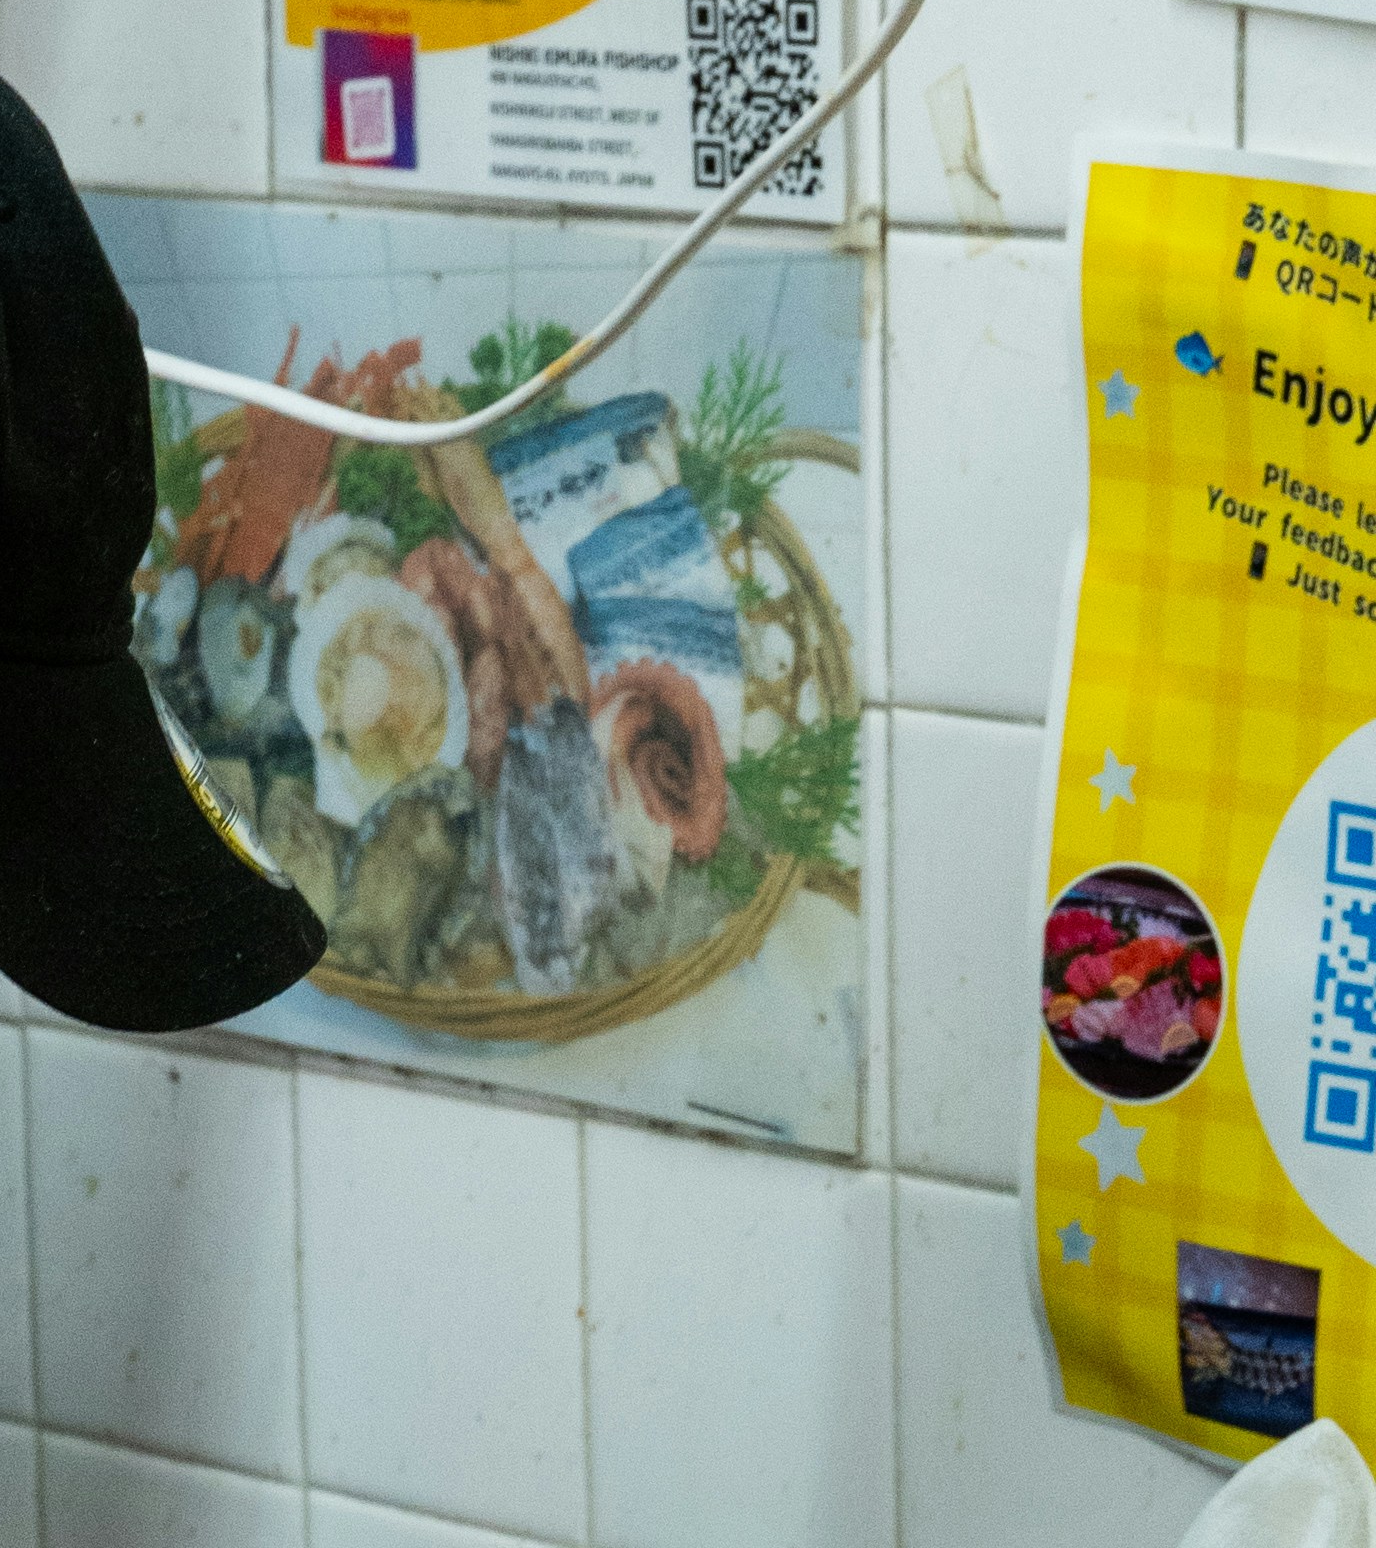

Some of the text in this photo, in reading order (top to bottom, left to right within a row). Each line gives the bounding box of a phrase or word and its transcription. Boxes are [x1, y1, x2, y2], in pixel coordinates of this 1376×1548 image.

[1252, 348, 1376, 446] Enjoy
[1207, 483, 1269, 529] Your
[1262, 462, 1344, 520] Please
[1287, 562, 1342, 607] Just
